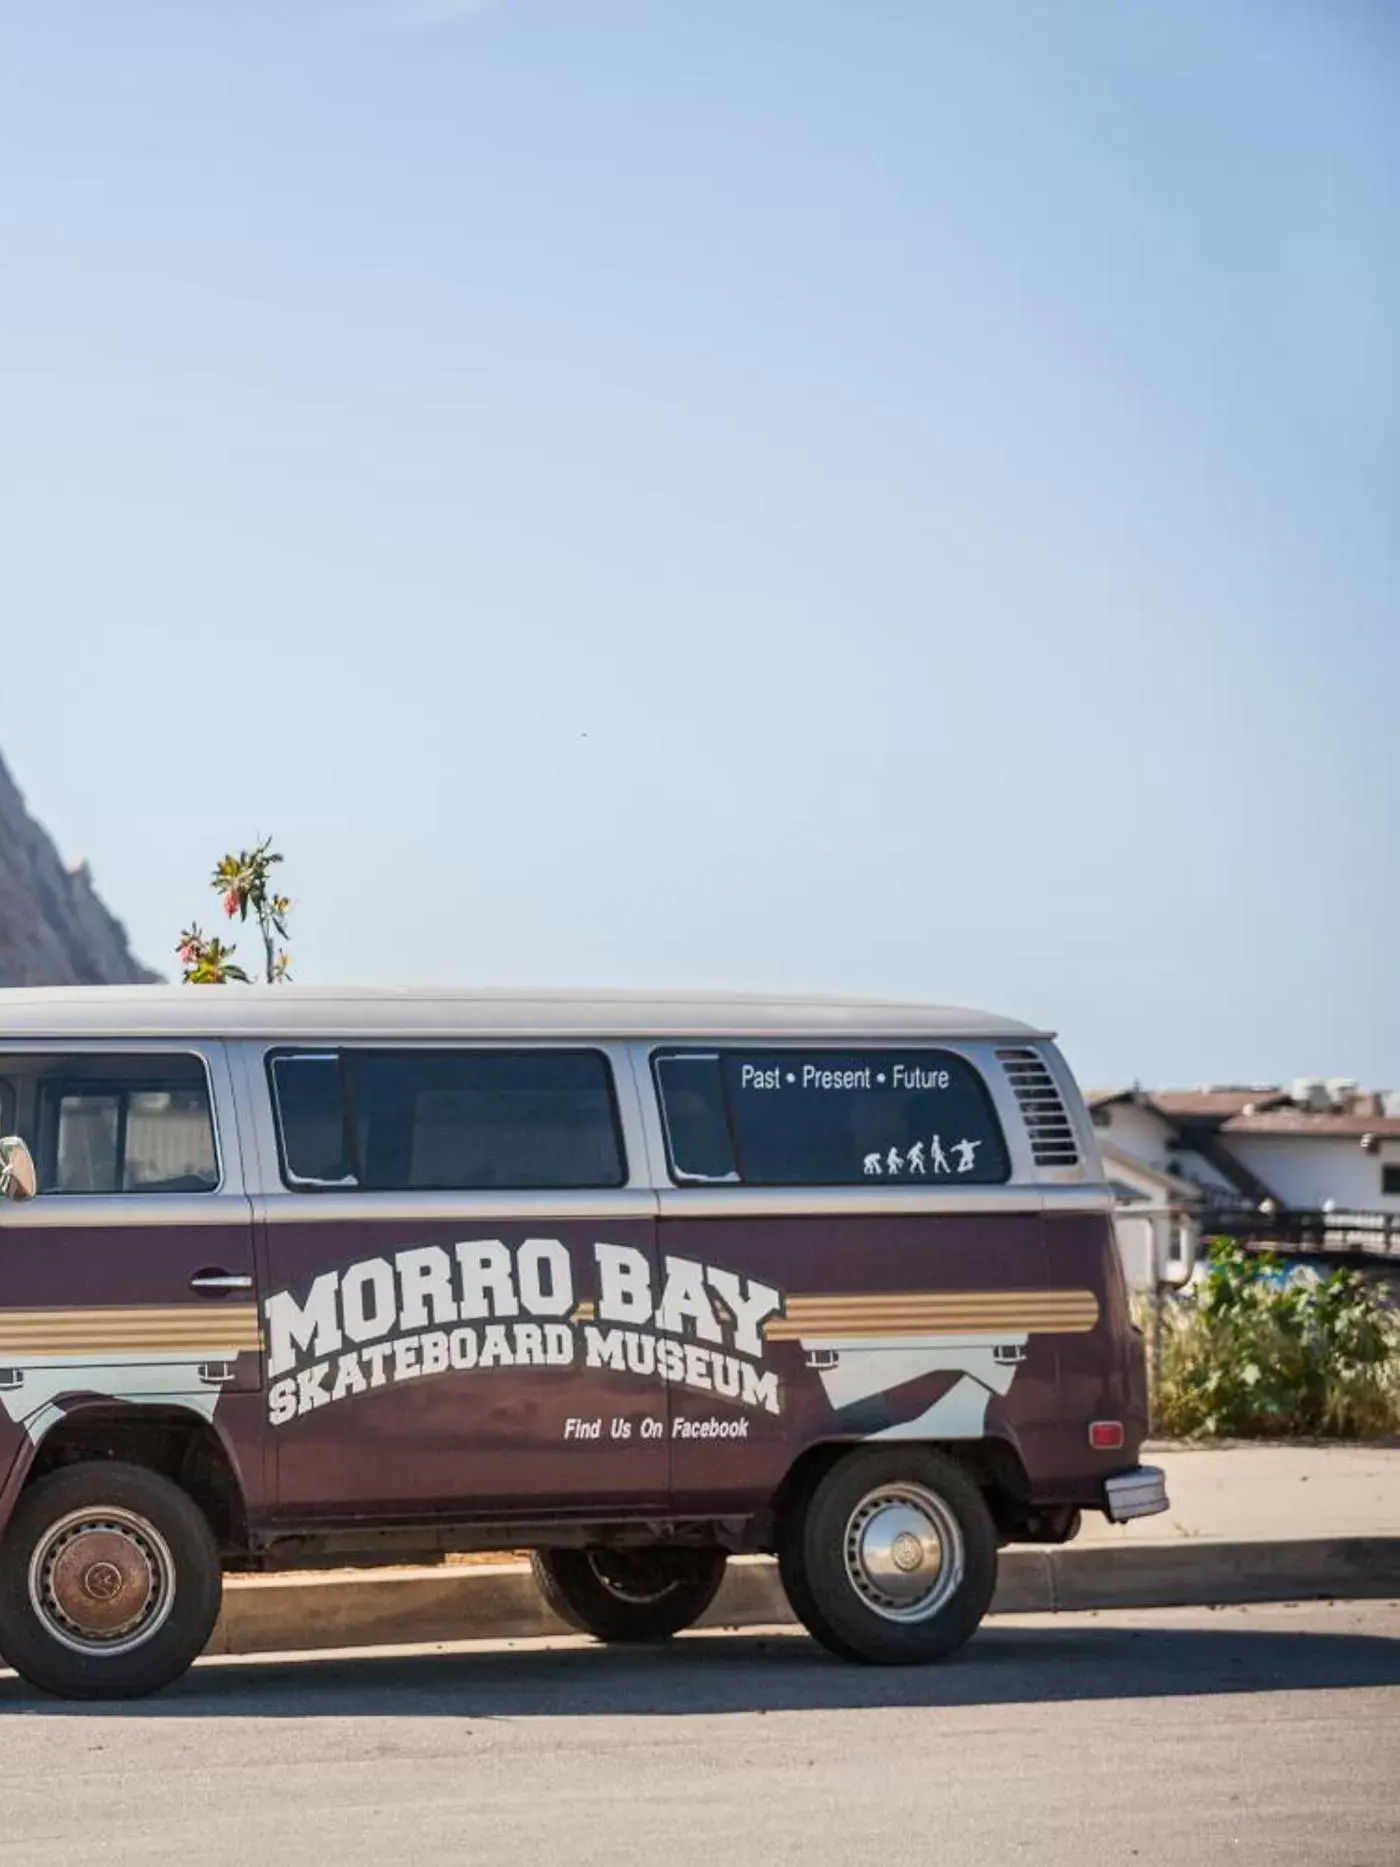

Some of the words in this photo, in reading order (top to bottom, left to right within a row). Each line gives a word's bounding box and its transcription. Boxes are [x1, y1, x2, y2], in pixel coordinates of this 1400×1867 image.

[741, 1064, 781, 1089] Past
[803, 1065, 871, 1089] Present
[892, 1065, 950, 1089] Future
[264, 1238, 574, 1379] MORRO
[594, 1242, 781, 1358] BAY
[268, 1323, 574, 1426] SKATEBOARD
[584, 1326, 781, 1415] MUSEUM
[563, 1417, 602, 1440] Find
[610, 1417, 632, 1439] Us
[639, 1417, 664, 1439] On
[671, 1417, 750, 1440] Facebook
